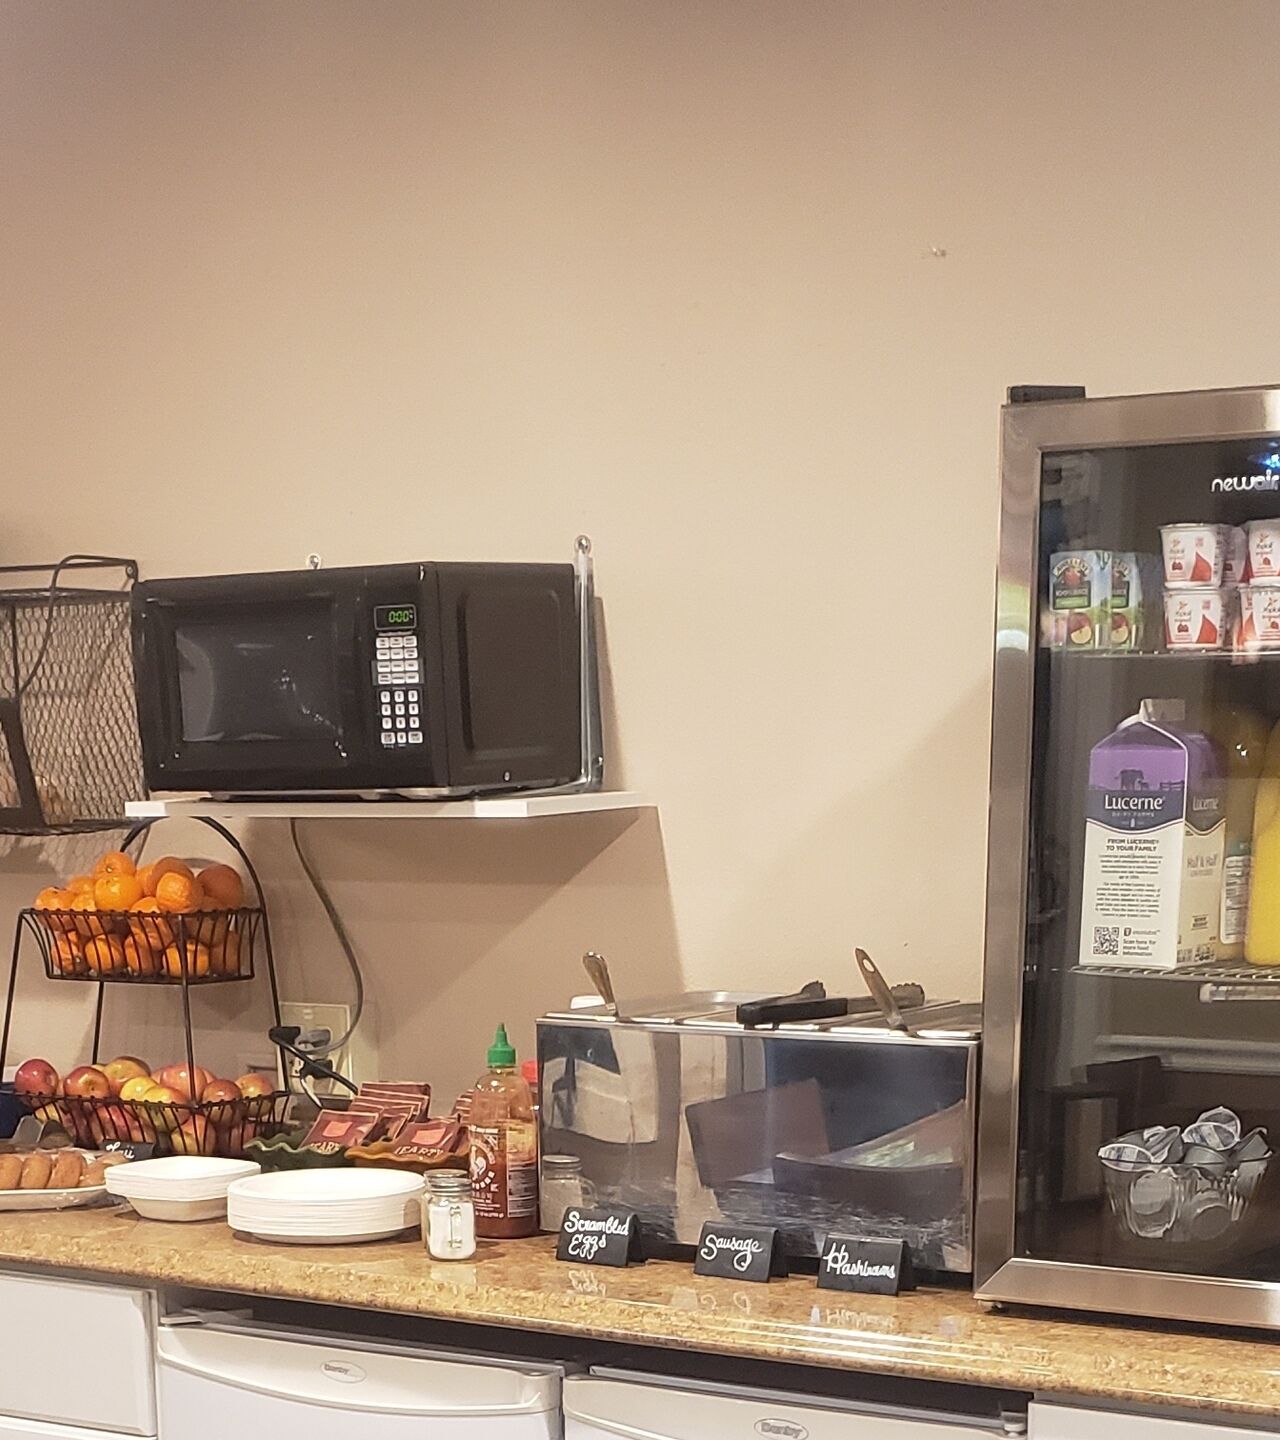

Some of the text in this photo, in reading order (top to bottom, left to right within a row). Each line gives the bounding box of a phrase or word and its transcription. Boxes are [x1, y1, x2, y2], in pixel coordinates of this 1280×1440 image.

[1211, 469, 1280, 492] newair
[1104, 794, 1164, 810] Lucerne
[564, 1211, 630, 1235] Scrambled
[568, 1233, 607, 1259] Eggs
[700, 1234, 763, 1271] Sausage
